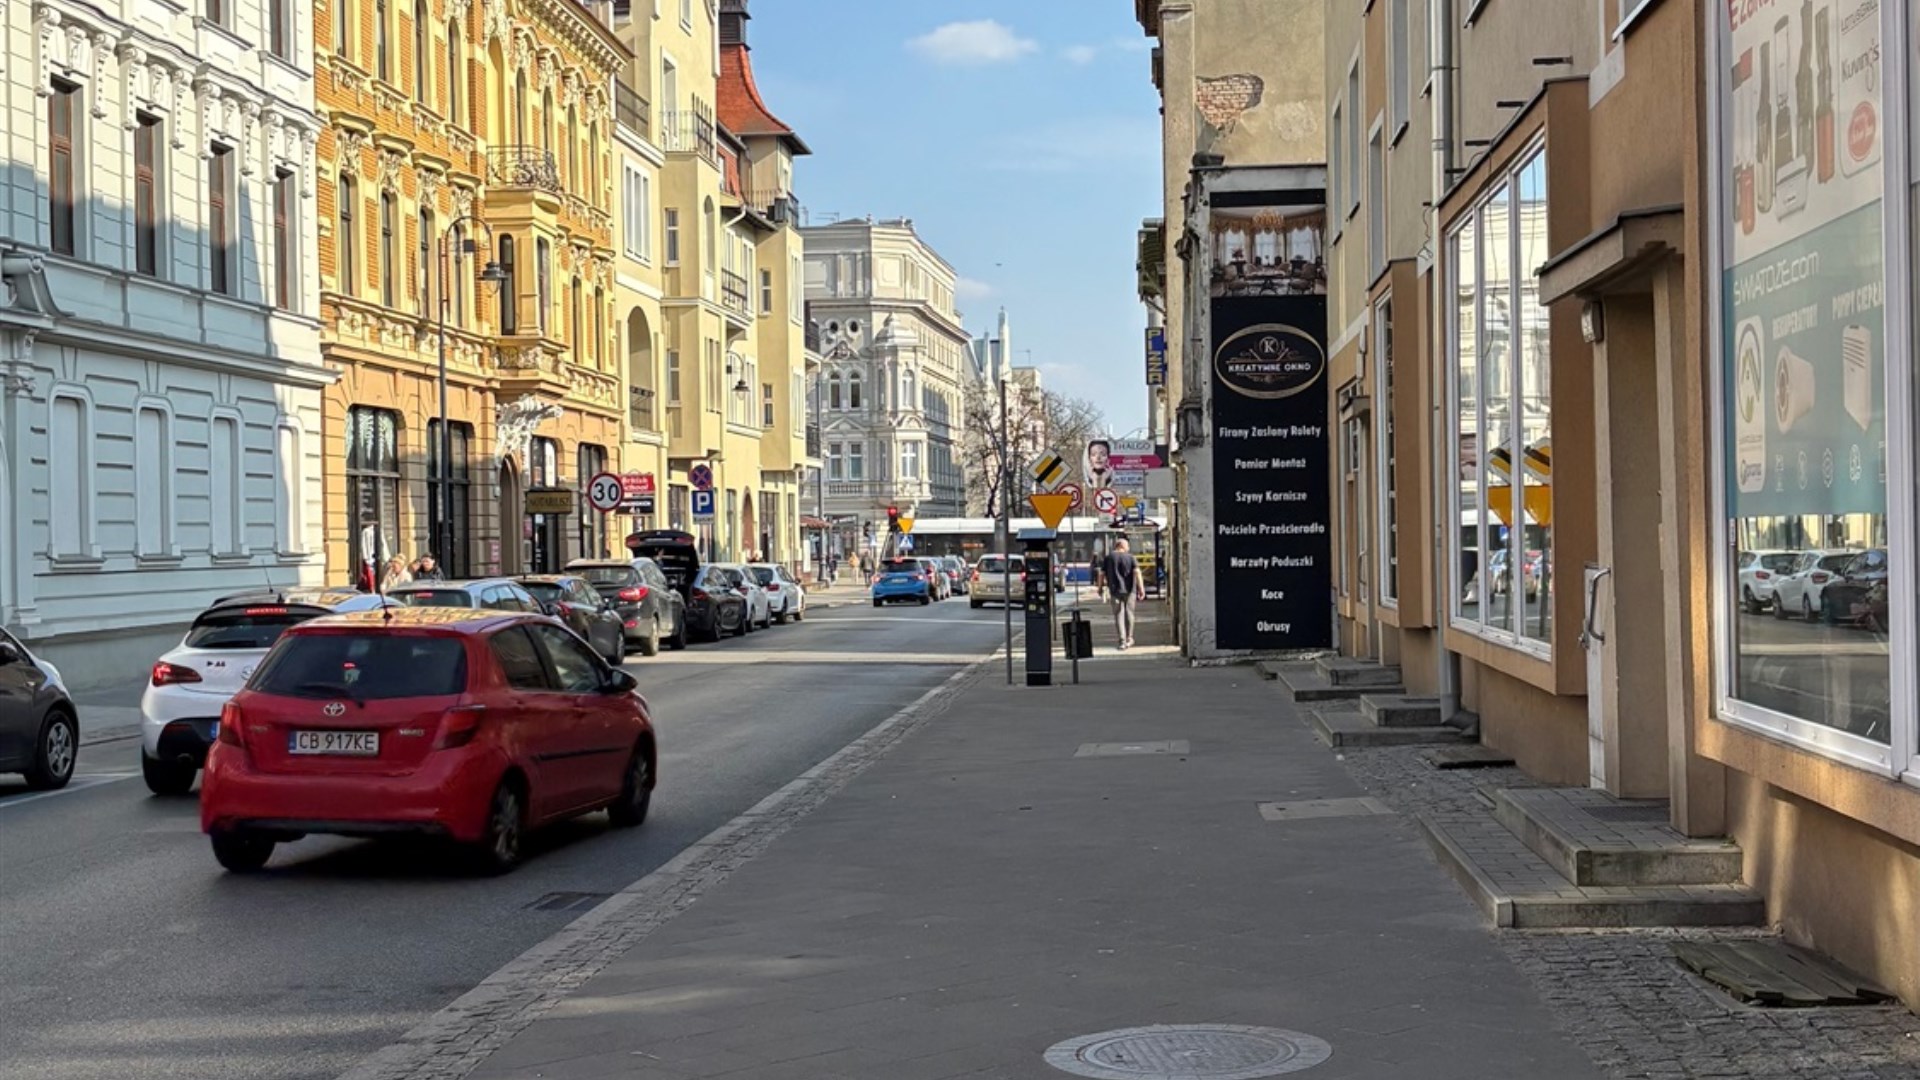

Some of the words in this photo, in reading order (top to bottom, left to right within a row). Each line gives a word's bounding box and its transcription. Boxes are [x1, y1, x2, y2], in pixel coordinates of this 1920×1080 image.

[1284, 362, 1311, 372] OKNO
[1219, 427, 1249, 439] Firany
[1291, 425, 1321, 437] Rolety
[1235, 458, 1268, 469] Pomiar
[1272, 457, 1306, 468] Montaż
[593, 483, 619, 502] 30
[1235, 491, 1263, 503] Szyny
[1265, 490, 1307, 501] Karnisze
[697, 493, 710, 511] P
[1219, 524, 1256, 535] Pościele
[1230, 556, 1268, 569] Narzuty
[1271, 555, 1313, 567] Poduszki
[1261, 589, 1284, 600] Koce
[1256, 621, 1291, 634] Obrusy
[299, 733, 319, 749] CB
[324, 733, 375, 751] 917KE
